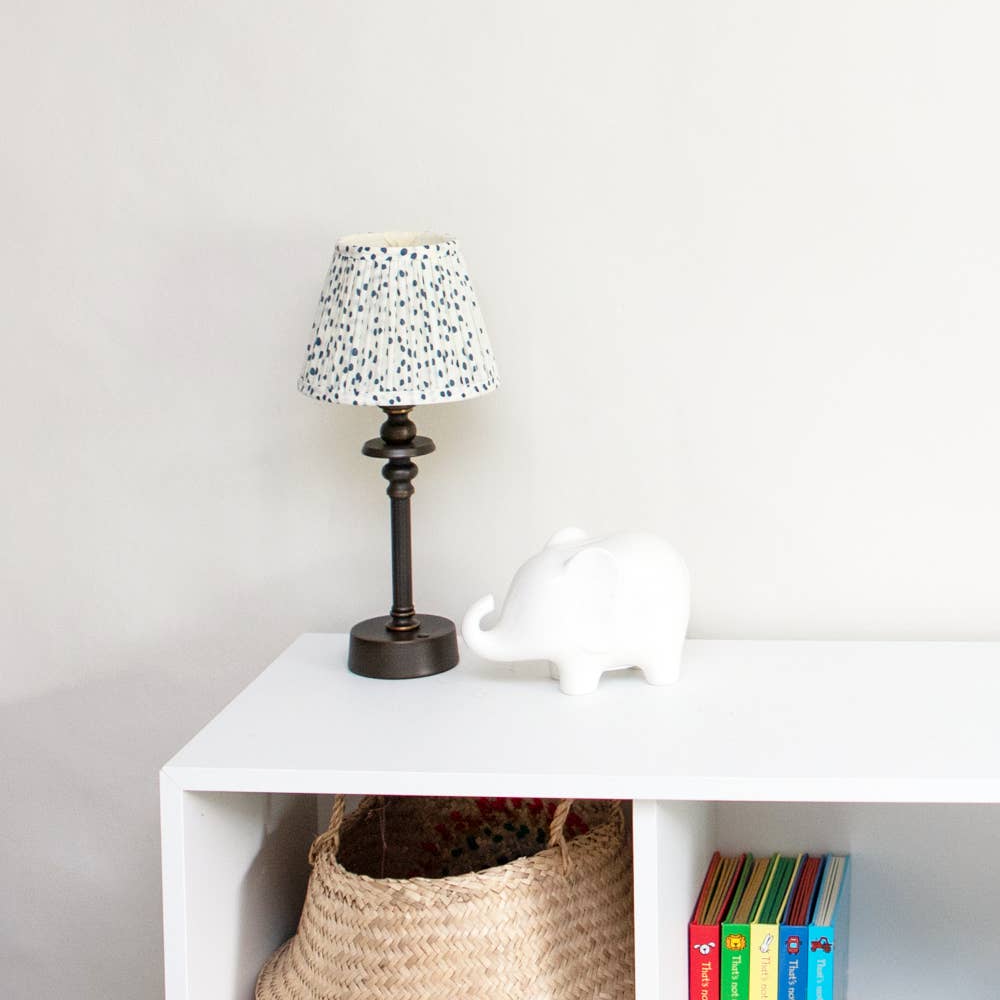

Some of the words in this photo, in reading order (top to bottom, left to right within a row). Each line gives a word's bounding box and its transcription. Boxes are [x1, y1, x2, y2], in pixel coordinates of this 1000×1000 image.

[701, 961, 712, 987] That's
[731, 955, 742, 980] That's
[760, 956, 771, 981] That's
[788, 960, 799, 985] That's
[816, 959, 826, 984] That's
[731, 982, 740, 998] not
[760, 984, 769, 998] not
